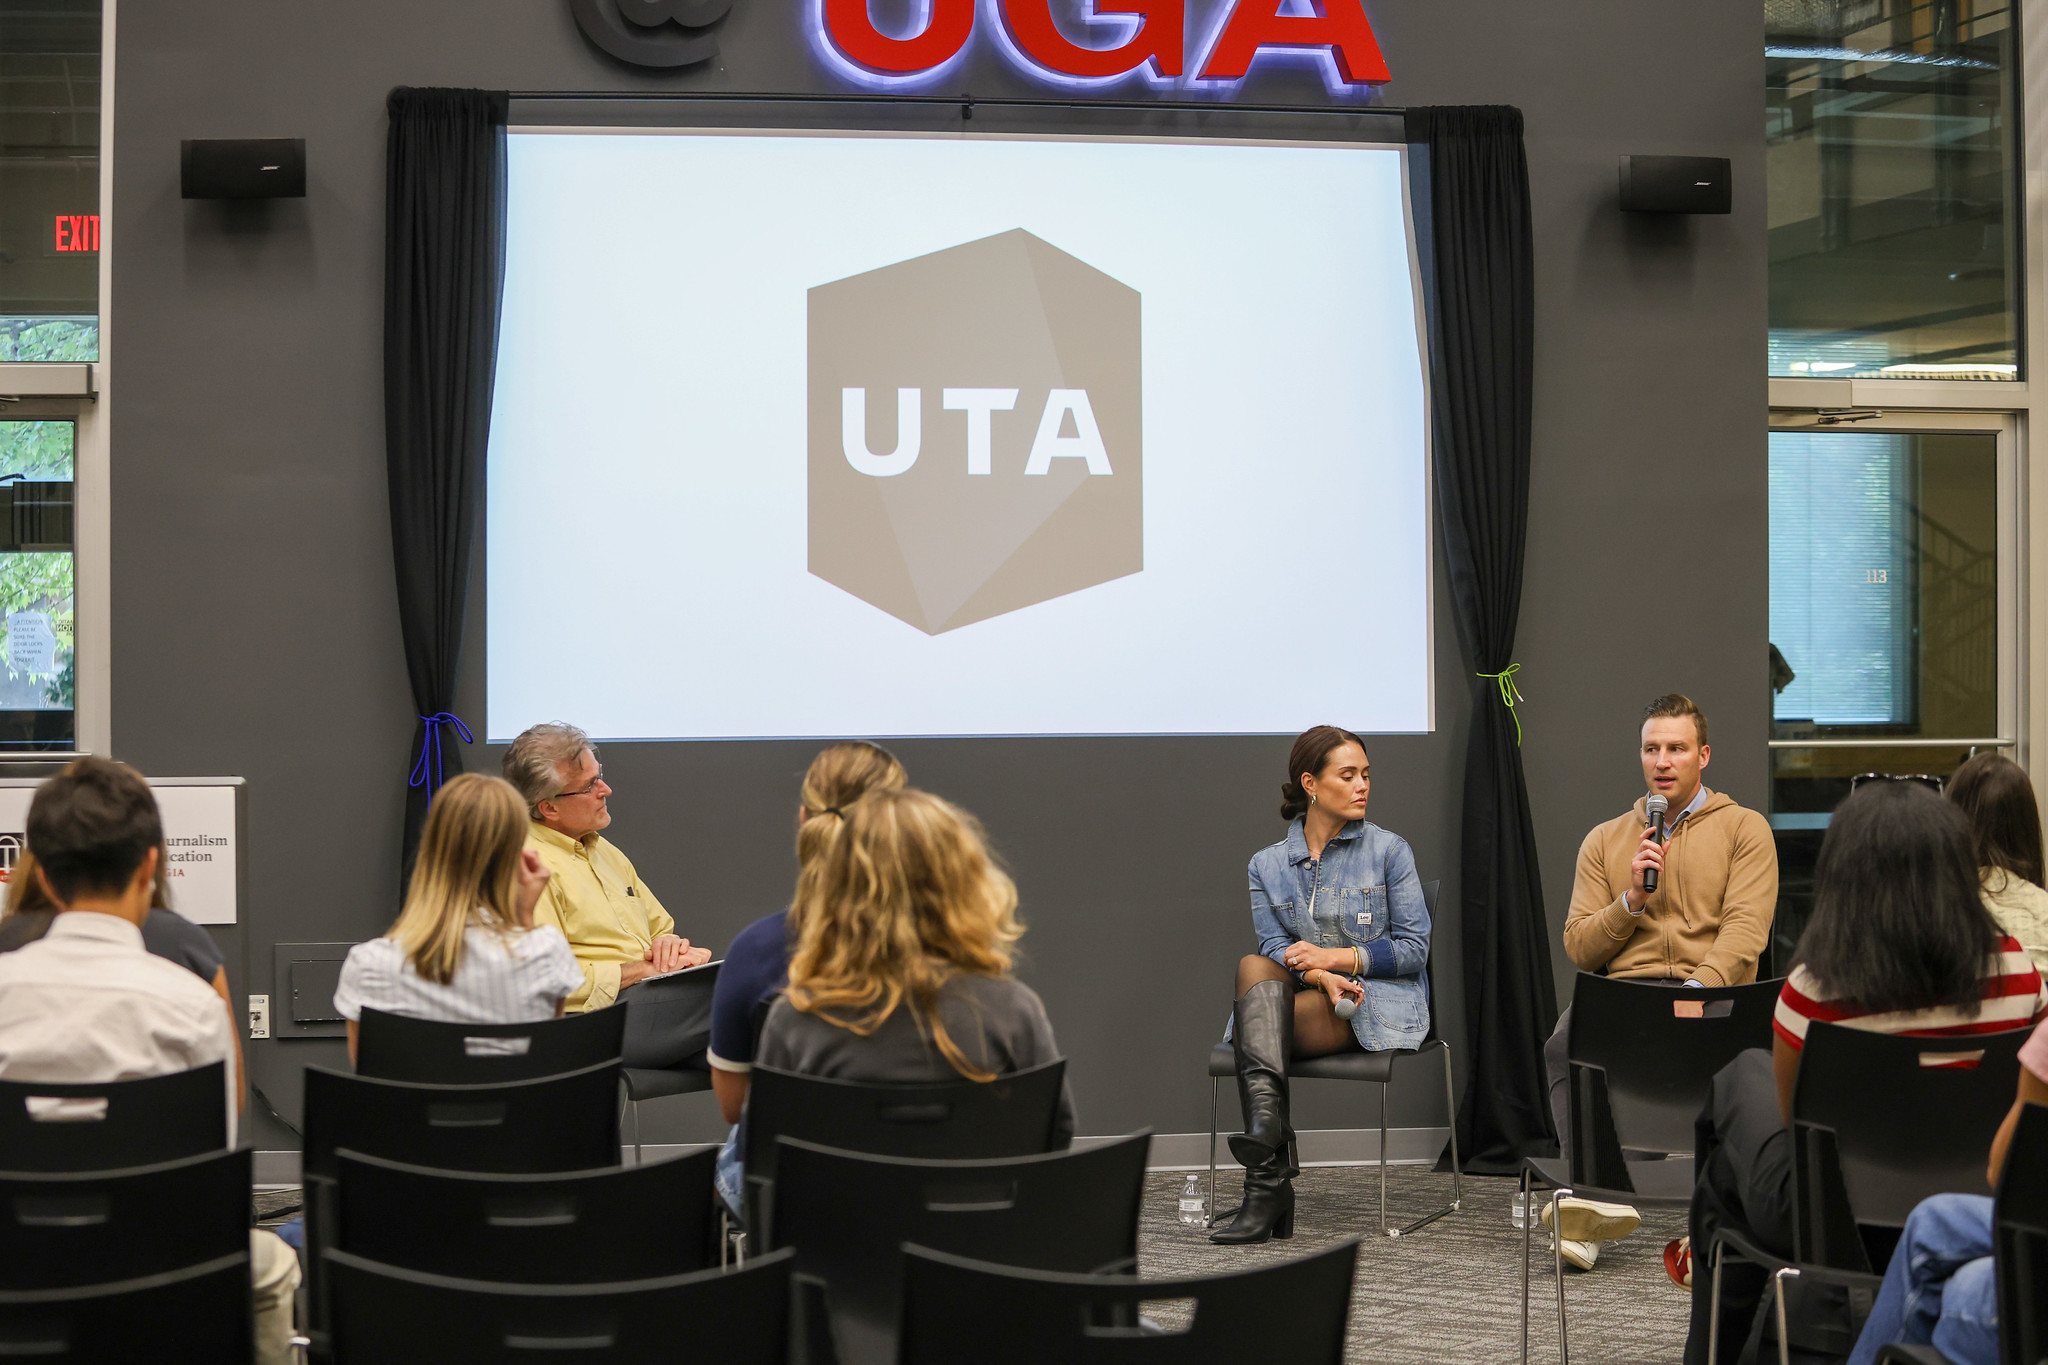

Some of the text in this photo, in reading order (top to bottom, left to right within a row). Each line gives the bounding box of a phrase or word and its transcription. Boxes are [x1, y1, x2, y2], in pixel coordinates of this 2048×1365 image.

[55, 215, 100, 251] EXIT
[842, 387, 1114, 477] UTA
[1865, 569, 1888, 584] 113
[166, 834, 228, 847] urnalism
[169, 850, 213, 862] cation
